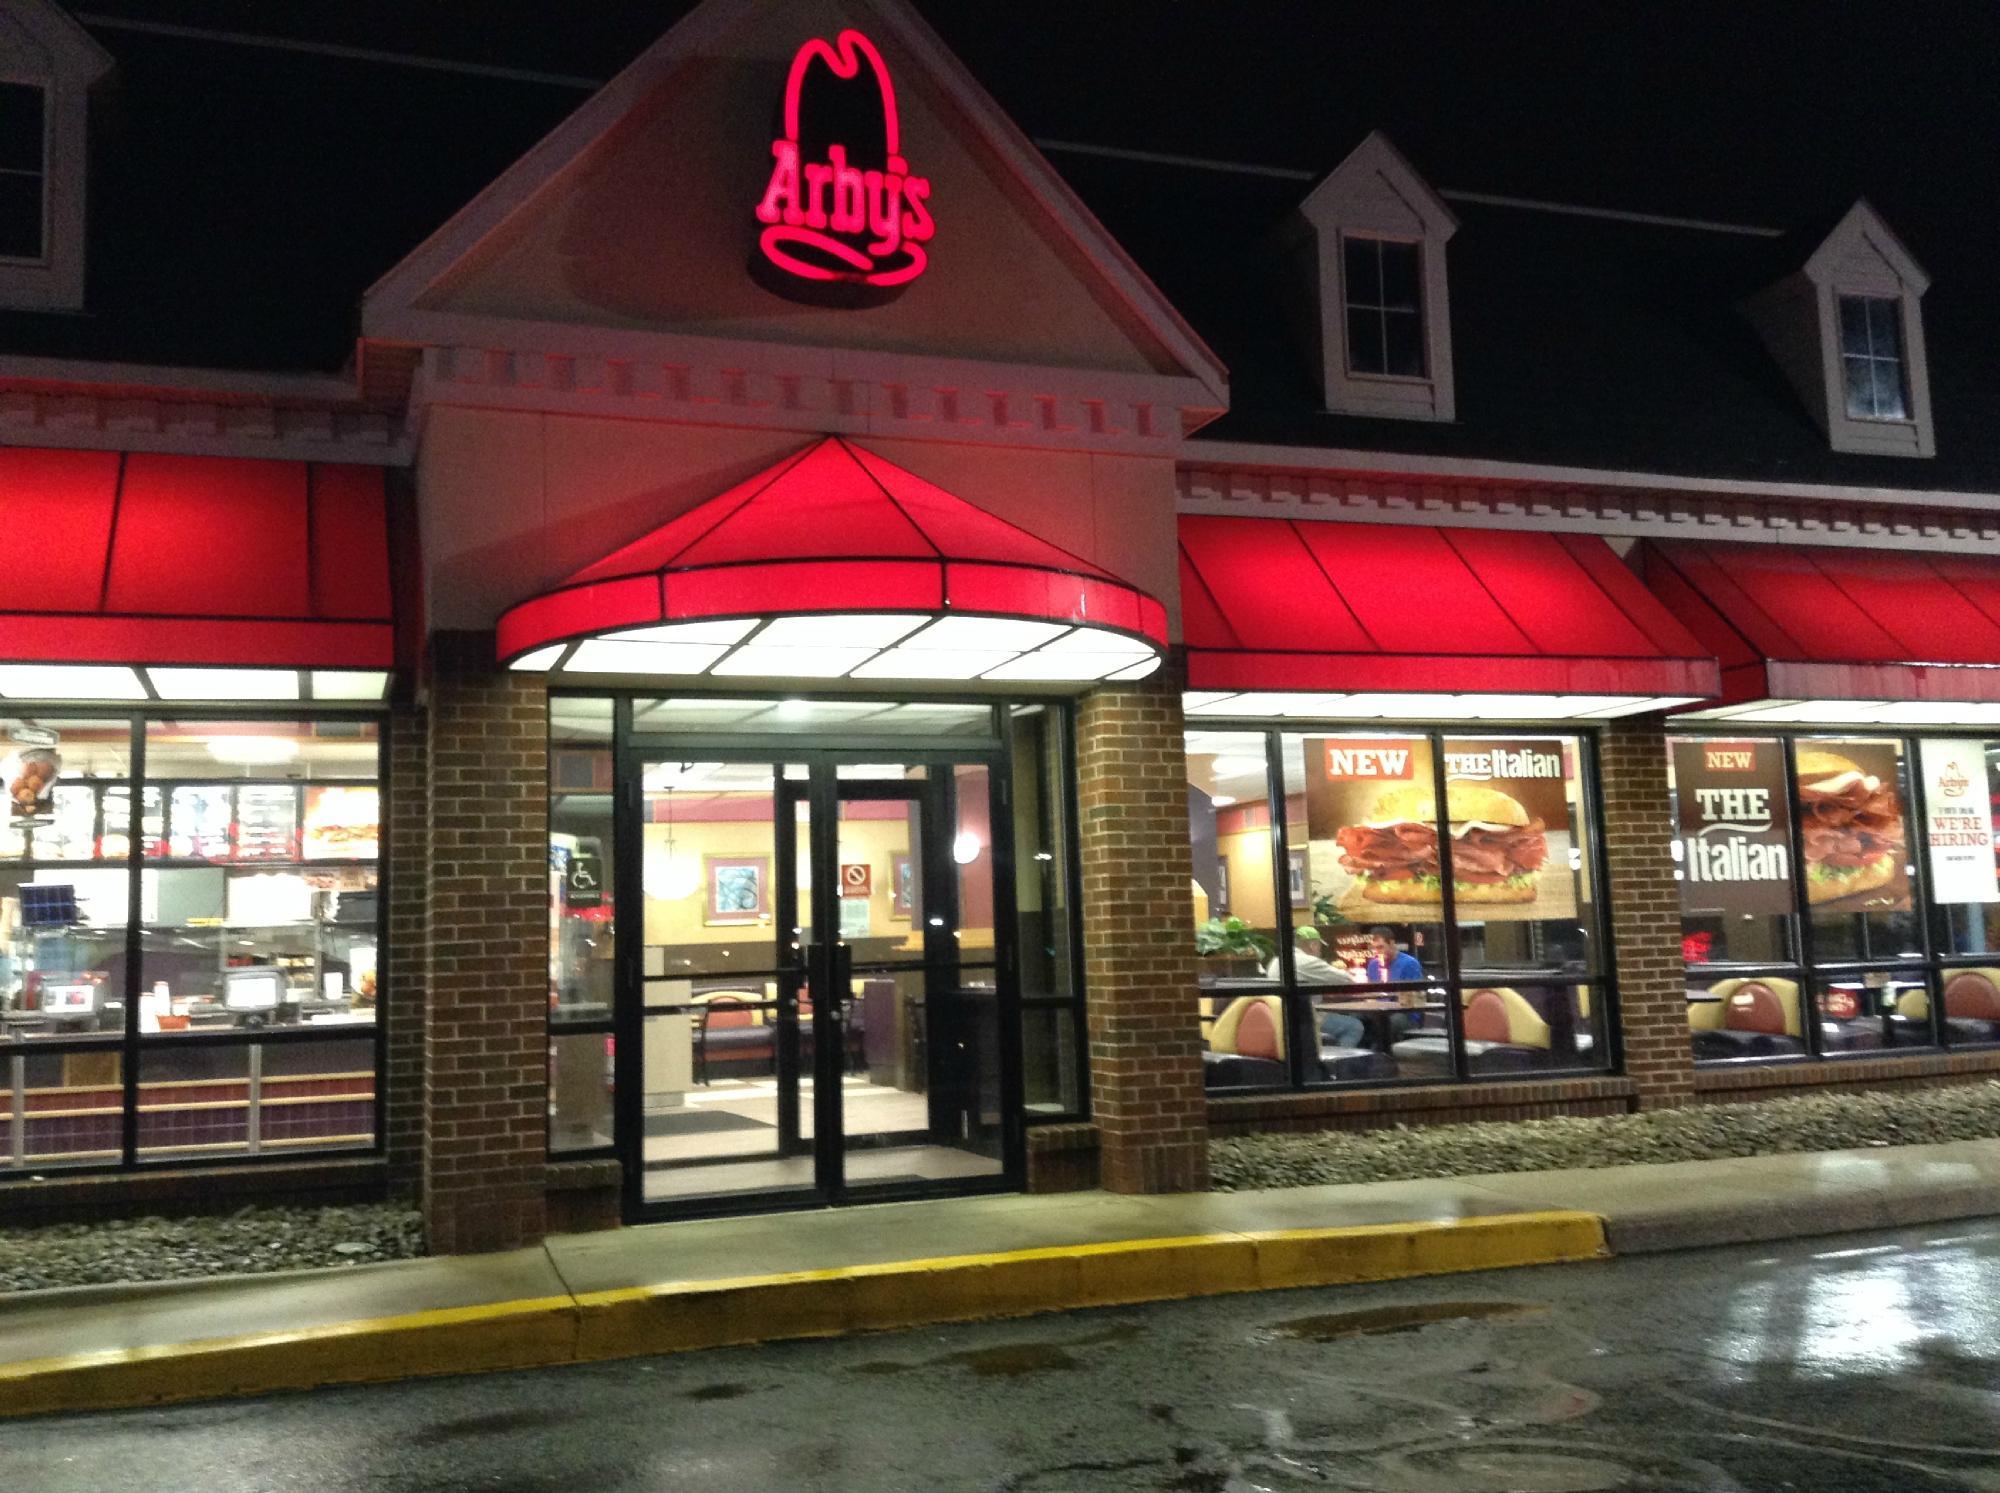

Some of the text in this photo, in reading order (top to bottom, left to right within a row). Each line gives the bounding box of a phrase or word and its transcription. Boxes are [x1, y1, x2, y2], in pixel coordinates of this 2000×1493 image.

[755, 139, 936, 257] Arby's
[1328, 748, 1409, 777] NEW
[1444, 749, 1561, 778] THE Italian
[1706, 751, 1753, 770] NEW
[1694, 788, 1771, 821] THE
[1932, 816, 1982, 831] WE'RE
[1928, 832, 1989, 847] HIRING
[1686, 836, 1789, 883] Italian
